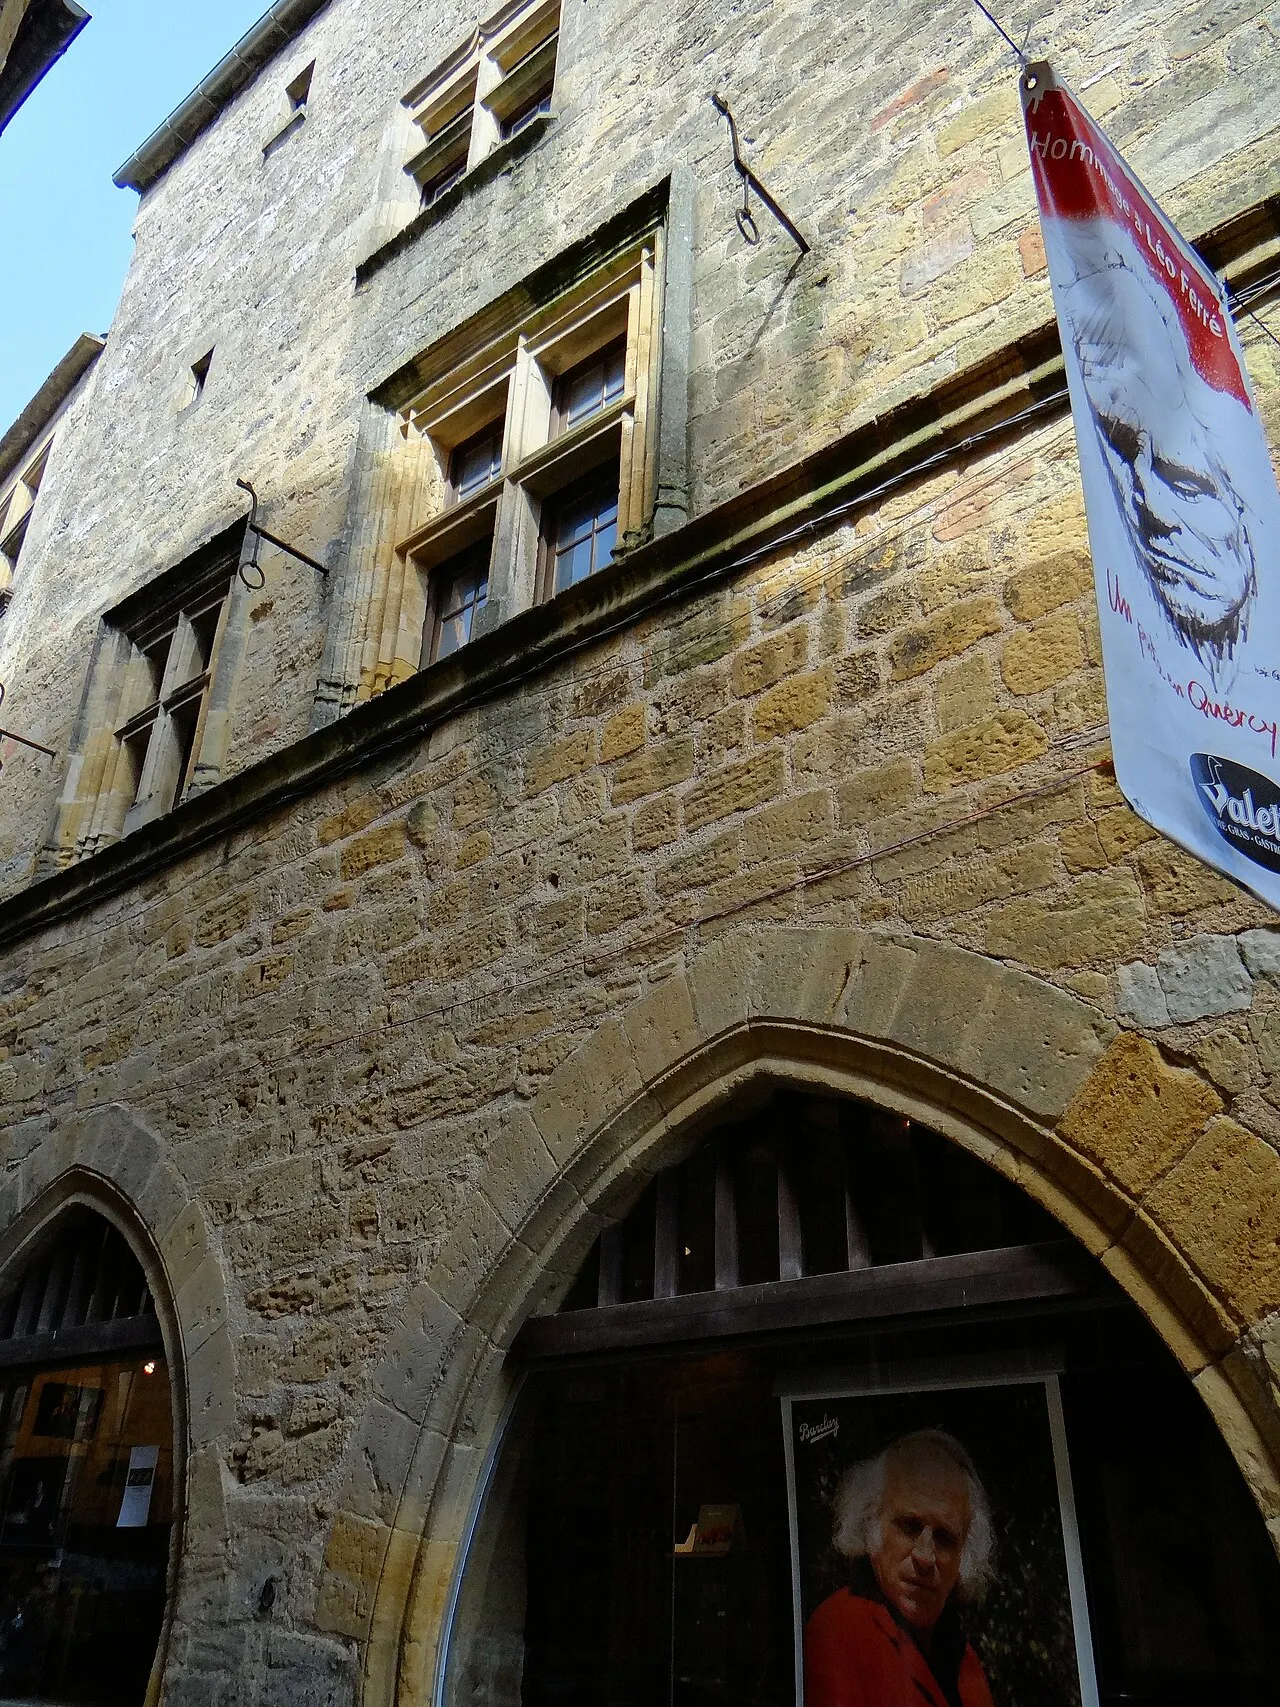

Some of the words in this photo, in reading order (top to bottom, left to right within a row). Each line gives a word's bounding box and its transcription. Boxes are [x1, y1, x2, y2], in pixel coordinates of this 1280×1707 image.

[1145, 223, 1177, 279] Léo
[1180, 269, 1224, 339] Ferré
[1187, 680, 1277, 760] Quercy
[1227, 824, 1250, 841] GRAS
[799, 1412, 840, 1443] Barclay
